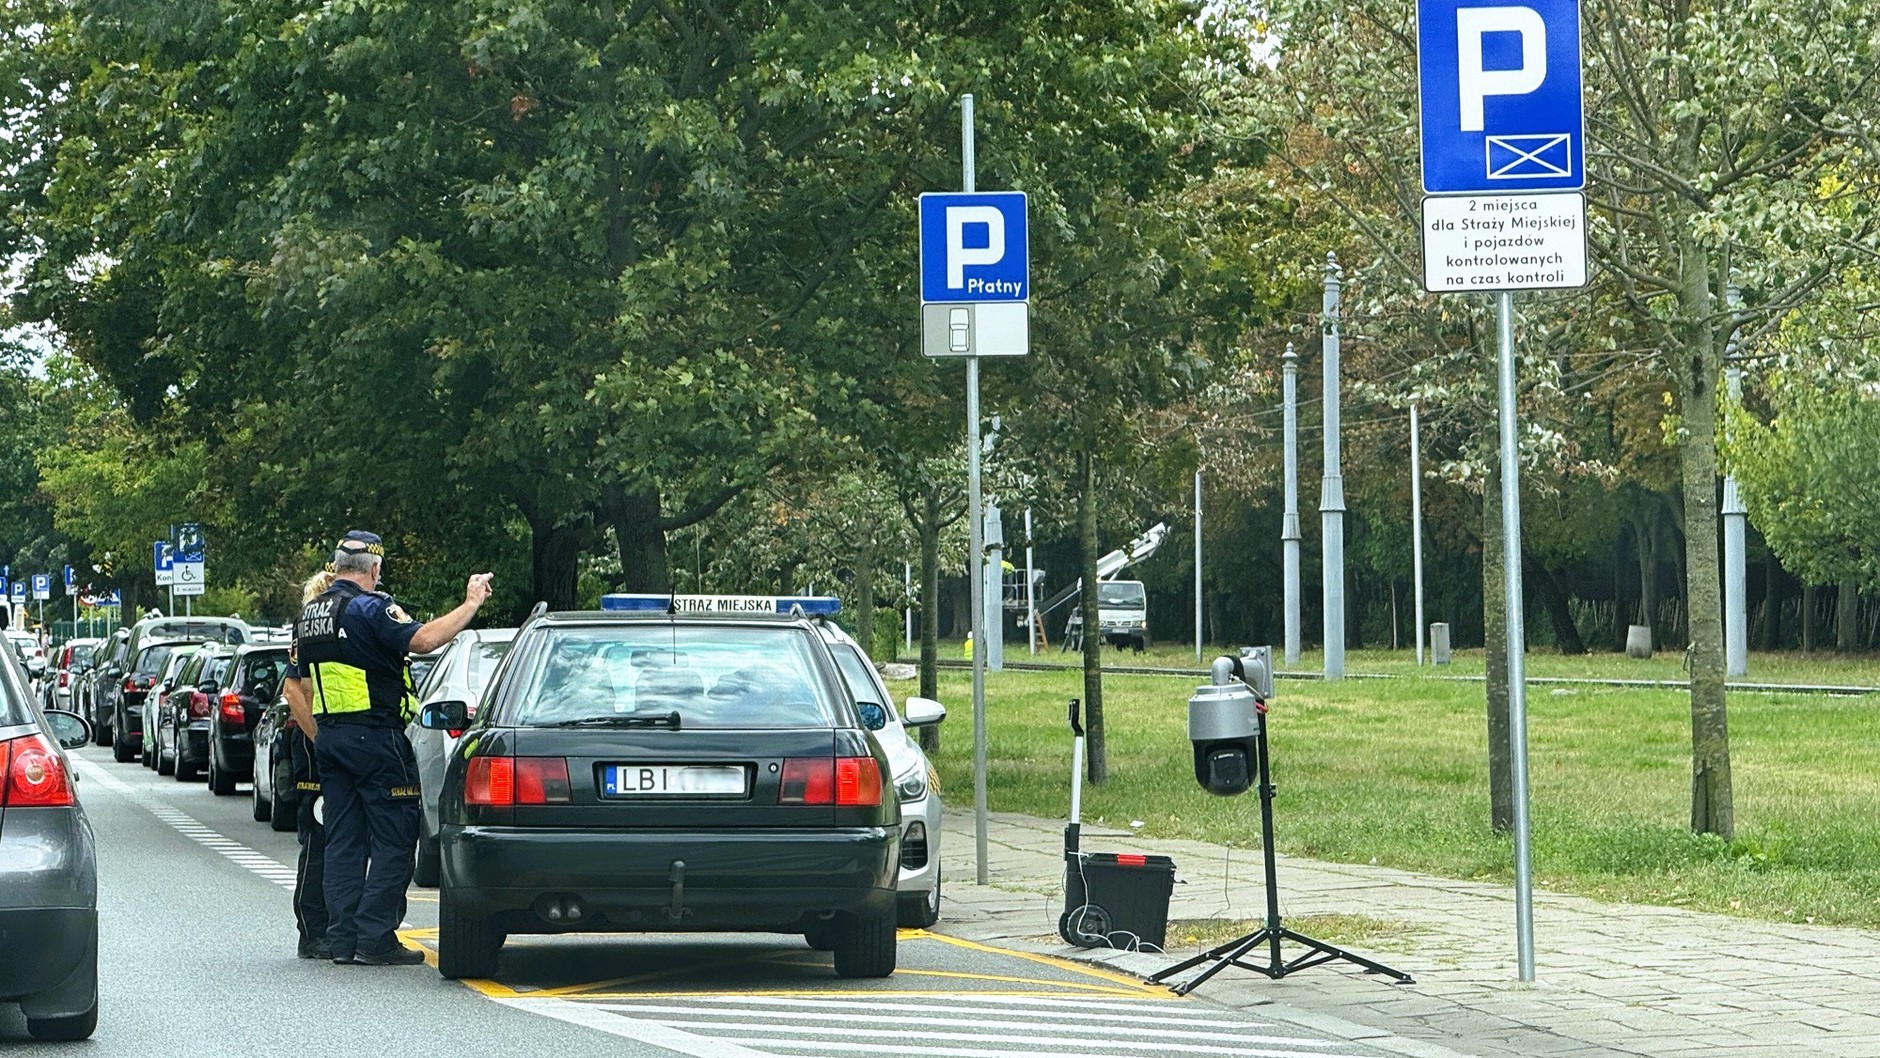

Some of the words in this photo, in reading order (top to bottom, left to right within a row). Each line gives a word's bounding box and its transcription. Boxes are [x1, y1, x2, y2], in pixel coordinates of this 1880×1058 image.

[1456, 6, 1547, 132] P
[1469, 200, 1477, 212] 2
[1483, 199, 1538, 213] miejsca
[1431, 219, 1455, 231] dla
[1461, 217, 1505, 232] Straży
[1511, 215, 1576, 231] Miejskiej
[946, 206, 1005, 289] P
[1464, 236, 1468, 248] i
[1474, 235, 1545, 251] pojazdów
[1446, 252, 1563, 268] kontrolowanych
[1446, 276, 1464, 285] na
[1470, 275, 1501, 285] czas
[1507, 270, 1564, 284] kontroli
[968, 278, 1022, 297] Płatny
[302, 598, 334, 620] STRAŻ
[717, 599, 772, 611] MIEJSKA
